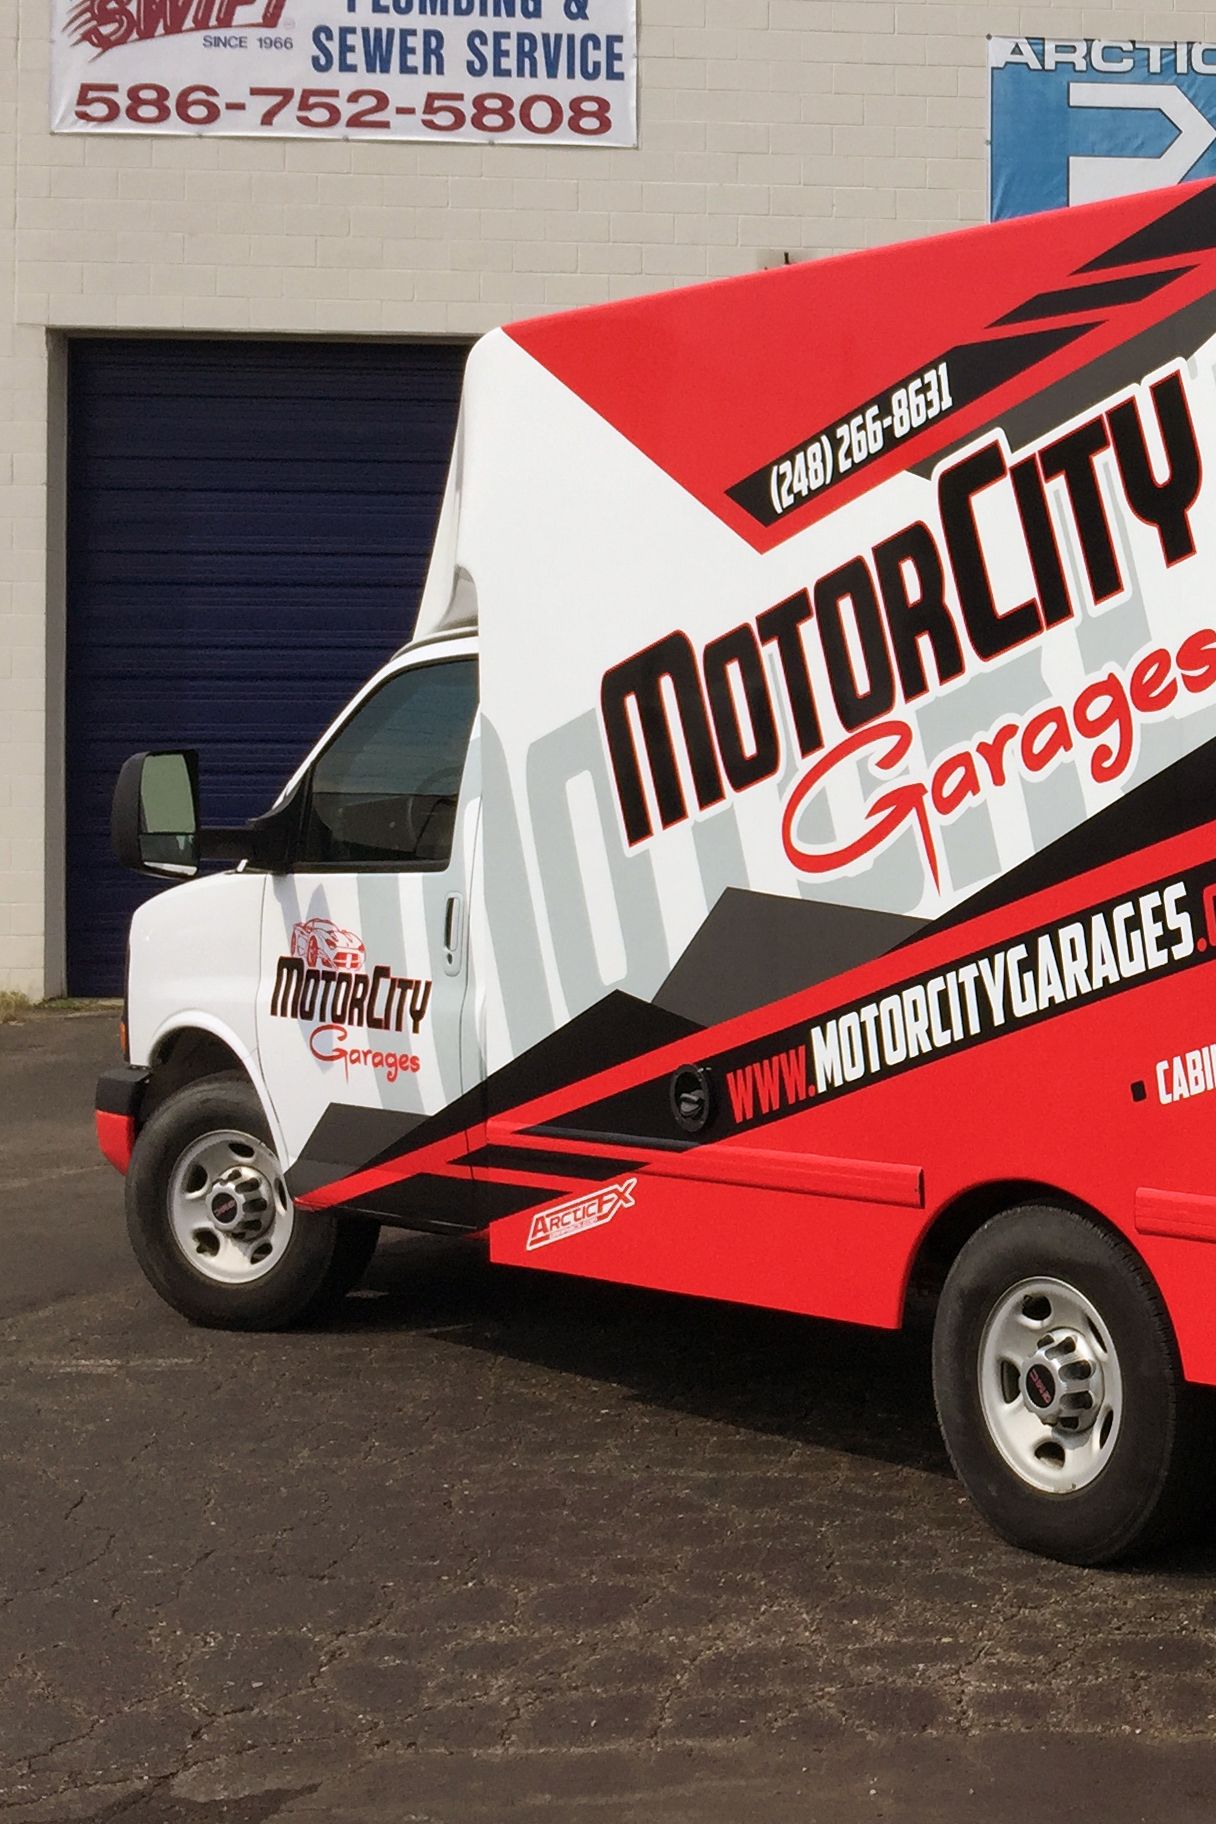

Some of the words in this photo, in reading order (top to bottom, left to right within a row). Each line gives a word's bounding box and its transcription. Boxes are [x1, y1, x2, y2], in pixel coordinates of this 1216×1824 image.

[203, 35, 248, 49] SINCE
[257, 36, 294, 50] 1966
[311, 25, 445, 76] SEWER
[466, 29, 625, 81] SERVICE
[74, 82, 612, 136] 586-752-5808
[770, 434, 834, 515] (248)
[836, 361, 953, 474] 266-8631
[309, 1024, 421, 1084] Garages
